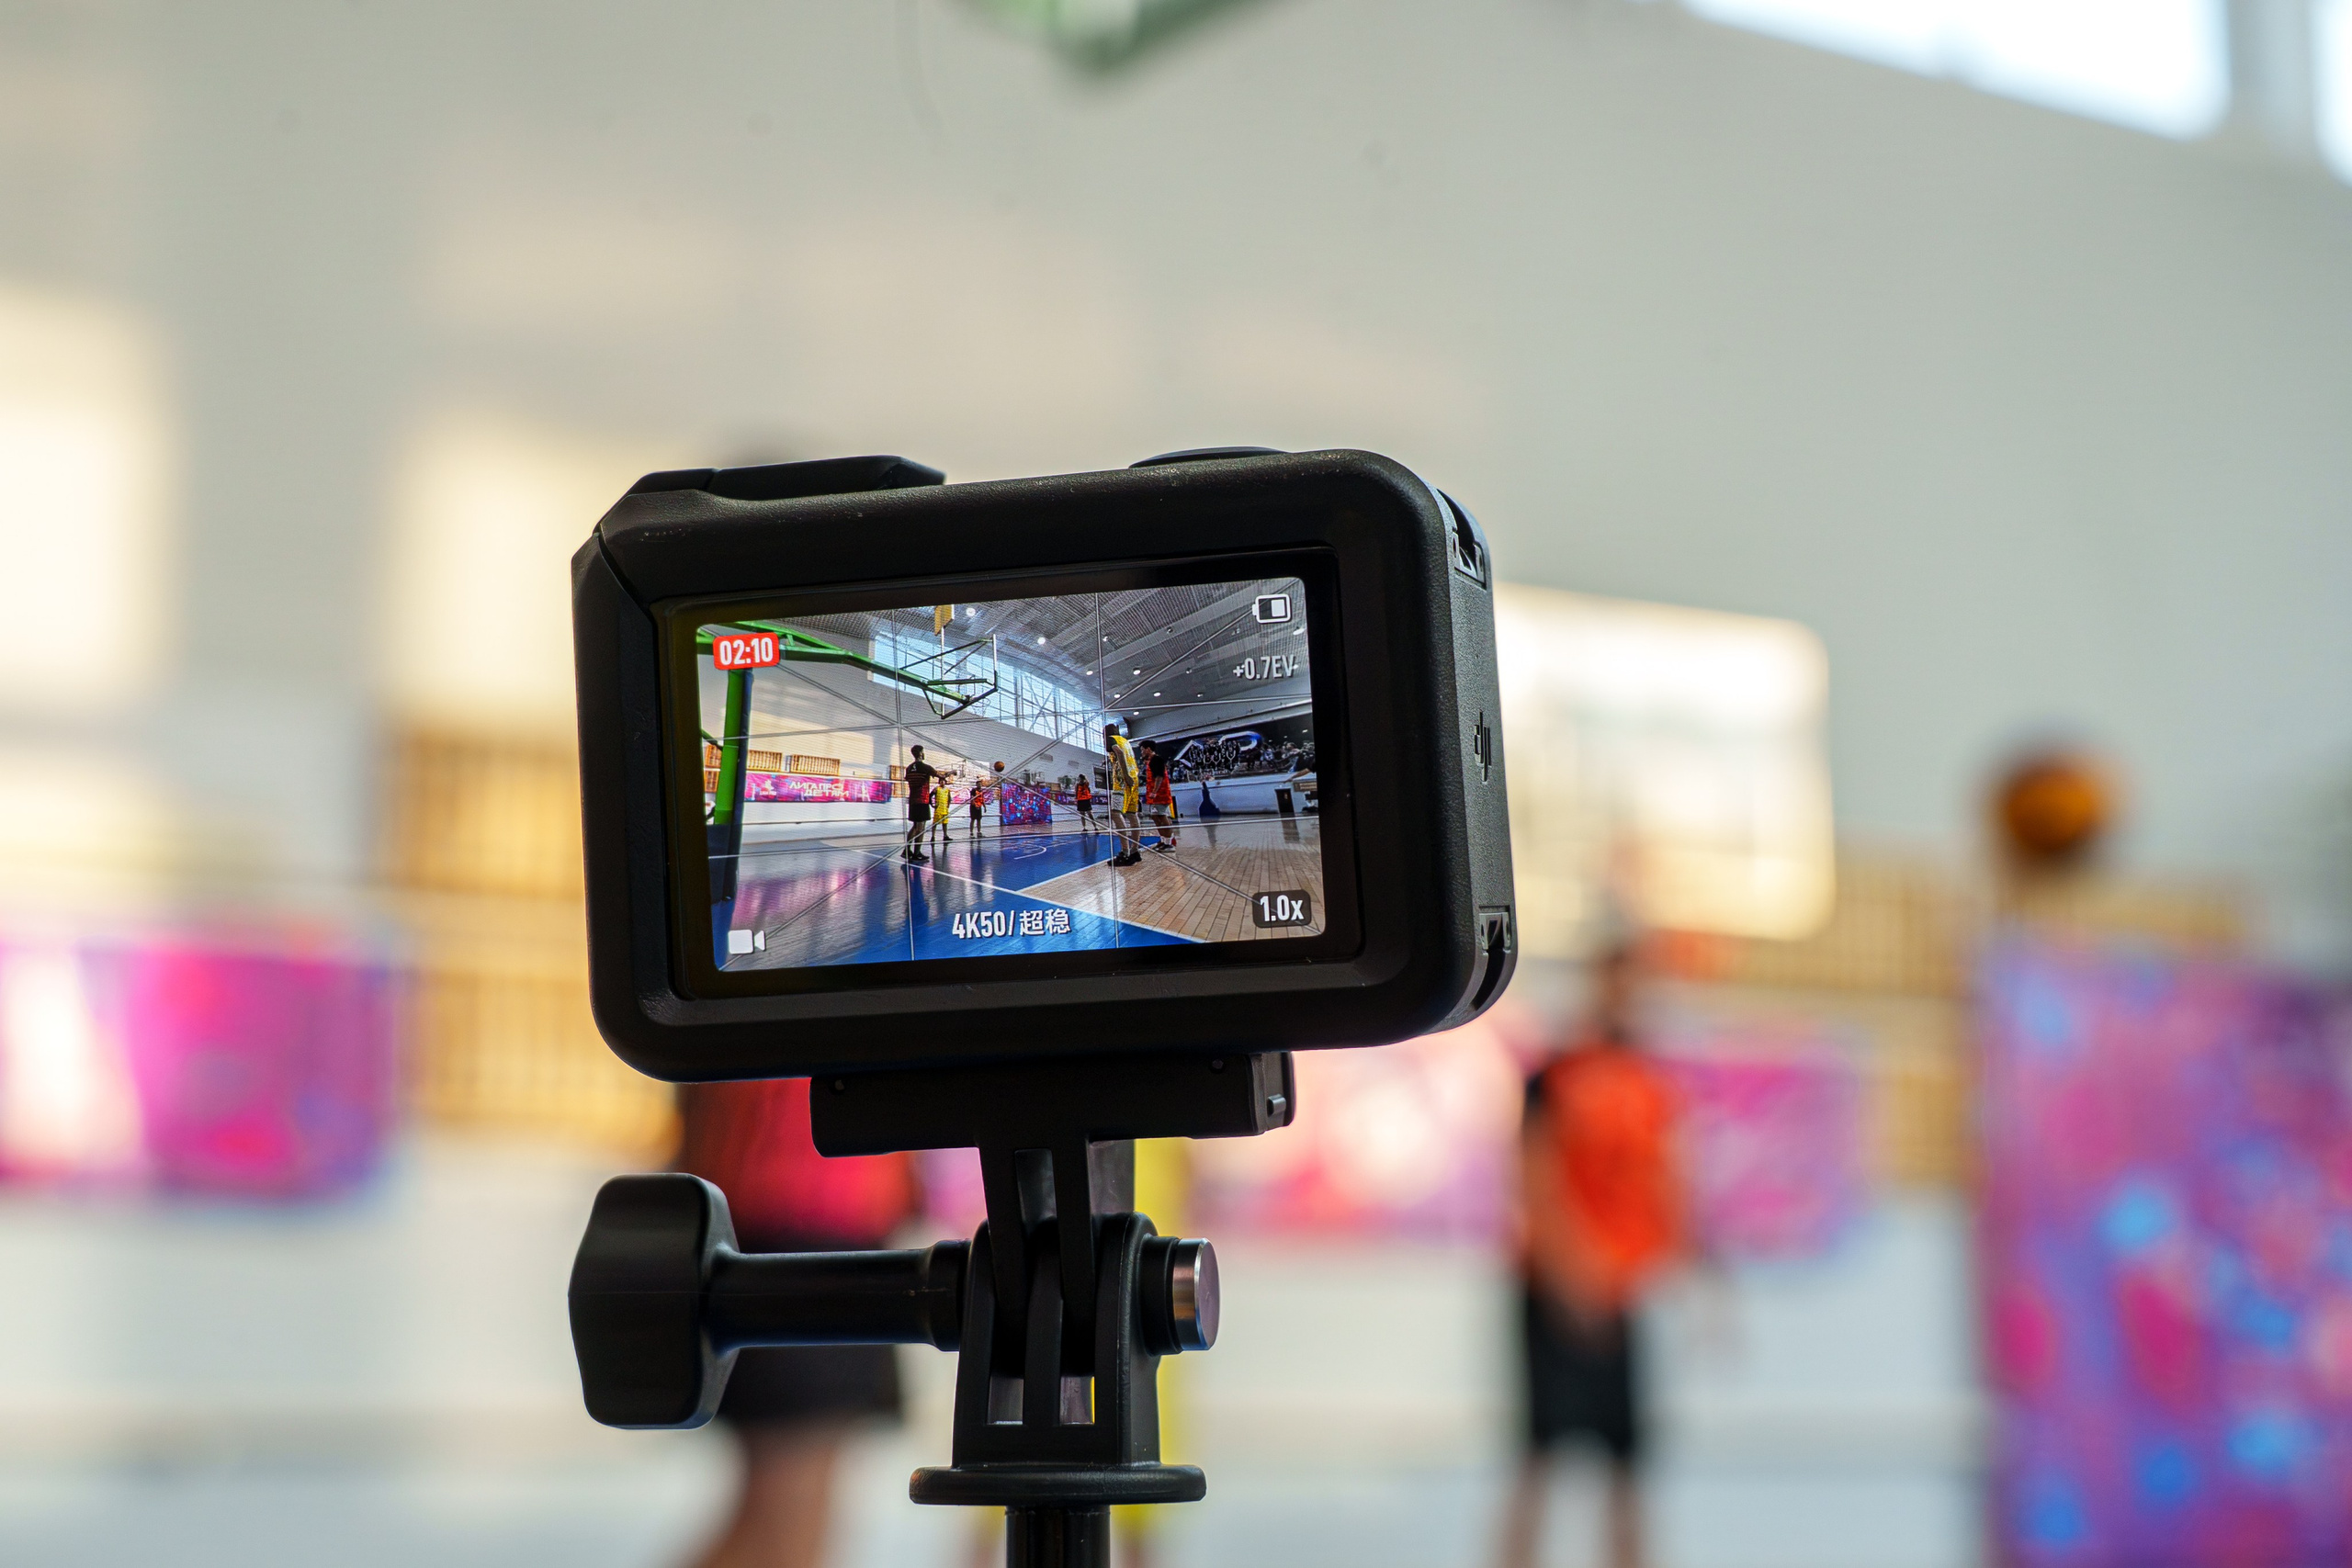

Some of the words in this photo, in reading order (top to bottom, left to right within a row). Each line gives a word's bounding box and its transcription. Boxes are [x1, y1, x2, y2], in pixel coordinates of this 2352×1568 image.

[719, 637, 774, 666] 02:10
[1233, 655, 1296, 680] +0.7EV
[1260, 895, 1305, 921] 1.0x
